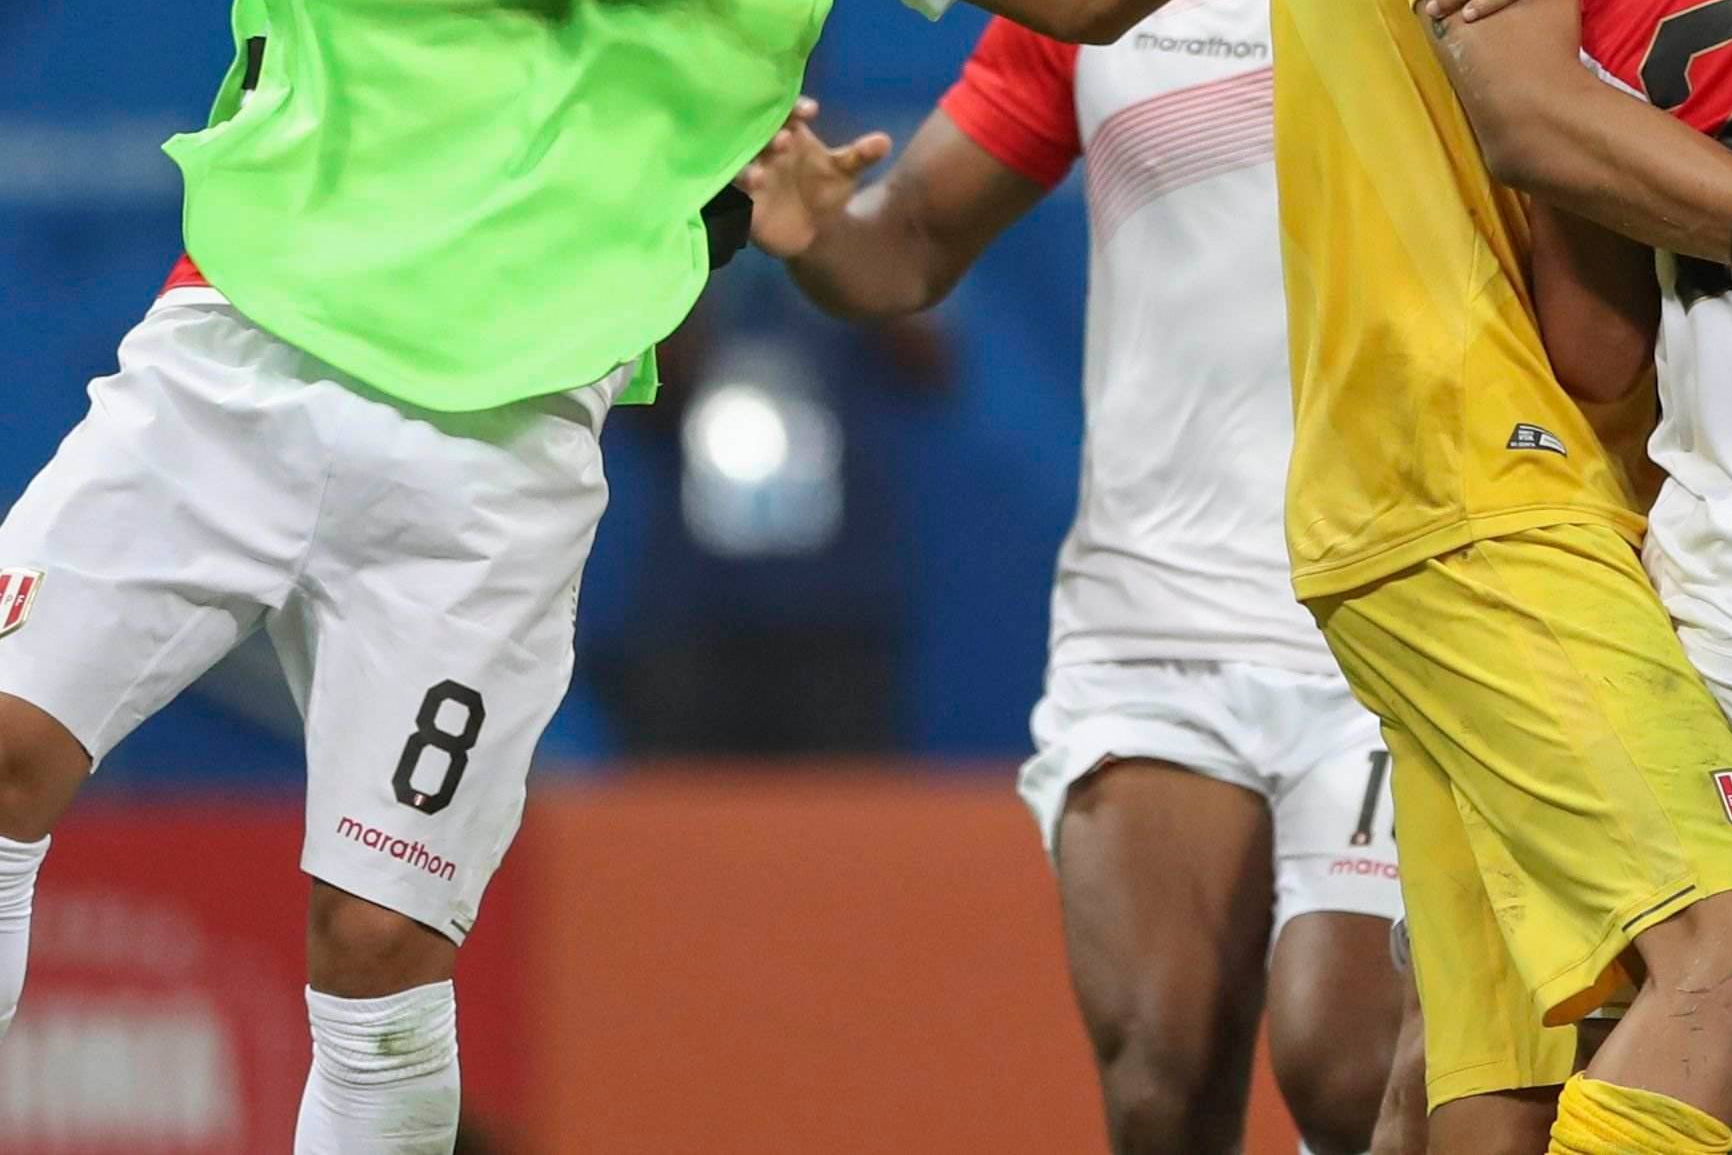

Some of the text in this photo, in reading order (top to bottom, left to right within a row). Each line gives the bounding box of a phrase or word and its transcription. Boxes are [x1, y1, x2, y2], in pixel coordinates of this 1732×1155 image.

[1133, 32, 1268, 60] marathon
[392, 679, 486, 815] 8
[1350, 749, 1397, 846] 1
[336, 816, 457, 882] marathon
[1330, 858, 1401, 880] mara
